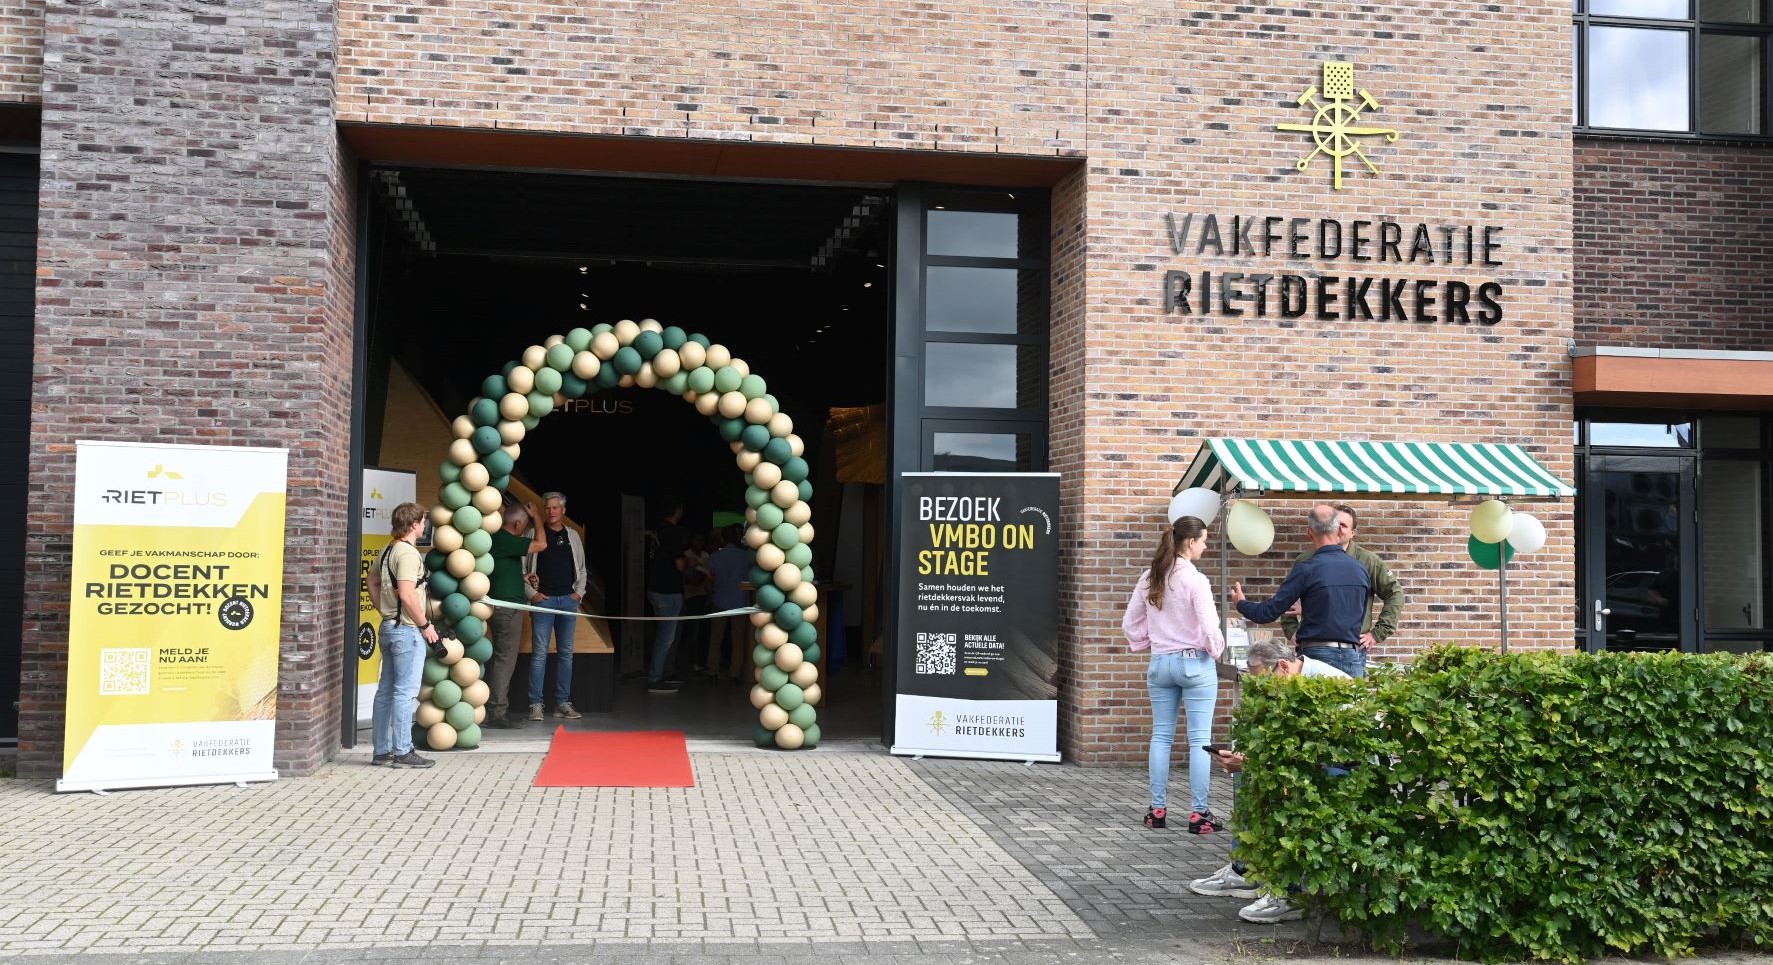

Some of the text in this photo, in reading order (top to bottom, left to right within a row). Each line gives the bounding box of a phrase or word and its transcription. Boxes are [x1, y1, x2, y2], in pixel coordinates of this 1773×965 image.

[1168, 212, 1503, 266] VAKFEDERATIE
[1166, 269, 1503, 326] RIETDEKKERS
[102, 489, 228, 507] RIETPLUS
[919, 496, 1001, 522] BEZOEK
[929, 523, 1034, 550] VMBO ON
[99, 549, 128, 557] GEEF
[145, 550, 226, 558] VAKMANSCHAP
[918, 549, 989, 576] STAGE
[109, 563, 230, 580] DOCENT
[85, 582, 269, 599] RIETDEKKEN
[918, 583, 945, 591] Samen
[946, 583, 976, 592] houden
[990, 584, 1005, 592] het
[918, 593, 1005, 604] rietdekkersvak levend,
[97, 602, 211, 615] GEZOCHT!
[929, 603, 940, 611] én
[941, 603, 949, 611] in
[950, 604, 960, 612] de
[961, 605, 1002, 613] toekomst.
[964, 641, 988, 649] ACTUELE
[159, 648, 193, 656] MELD
[956, 714, 1025, 726] VAKFEDERATIE
[955, 726, 1025, 738] RIETDEKKERS
[193, 738, 250, 748] VAKFEDERATIE
[192, 747, 251, 757] RIETDEKKERS
